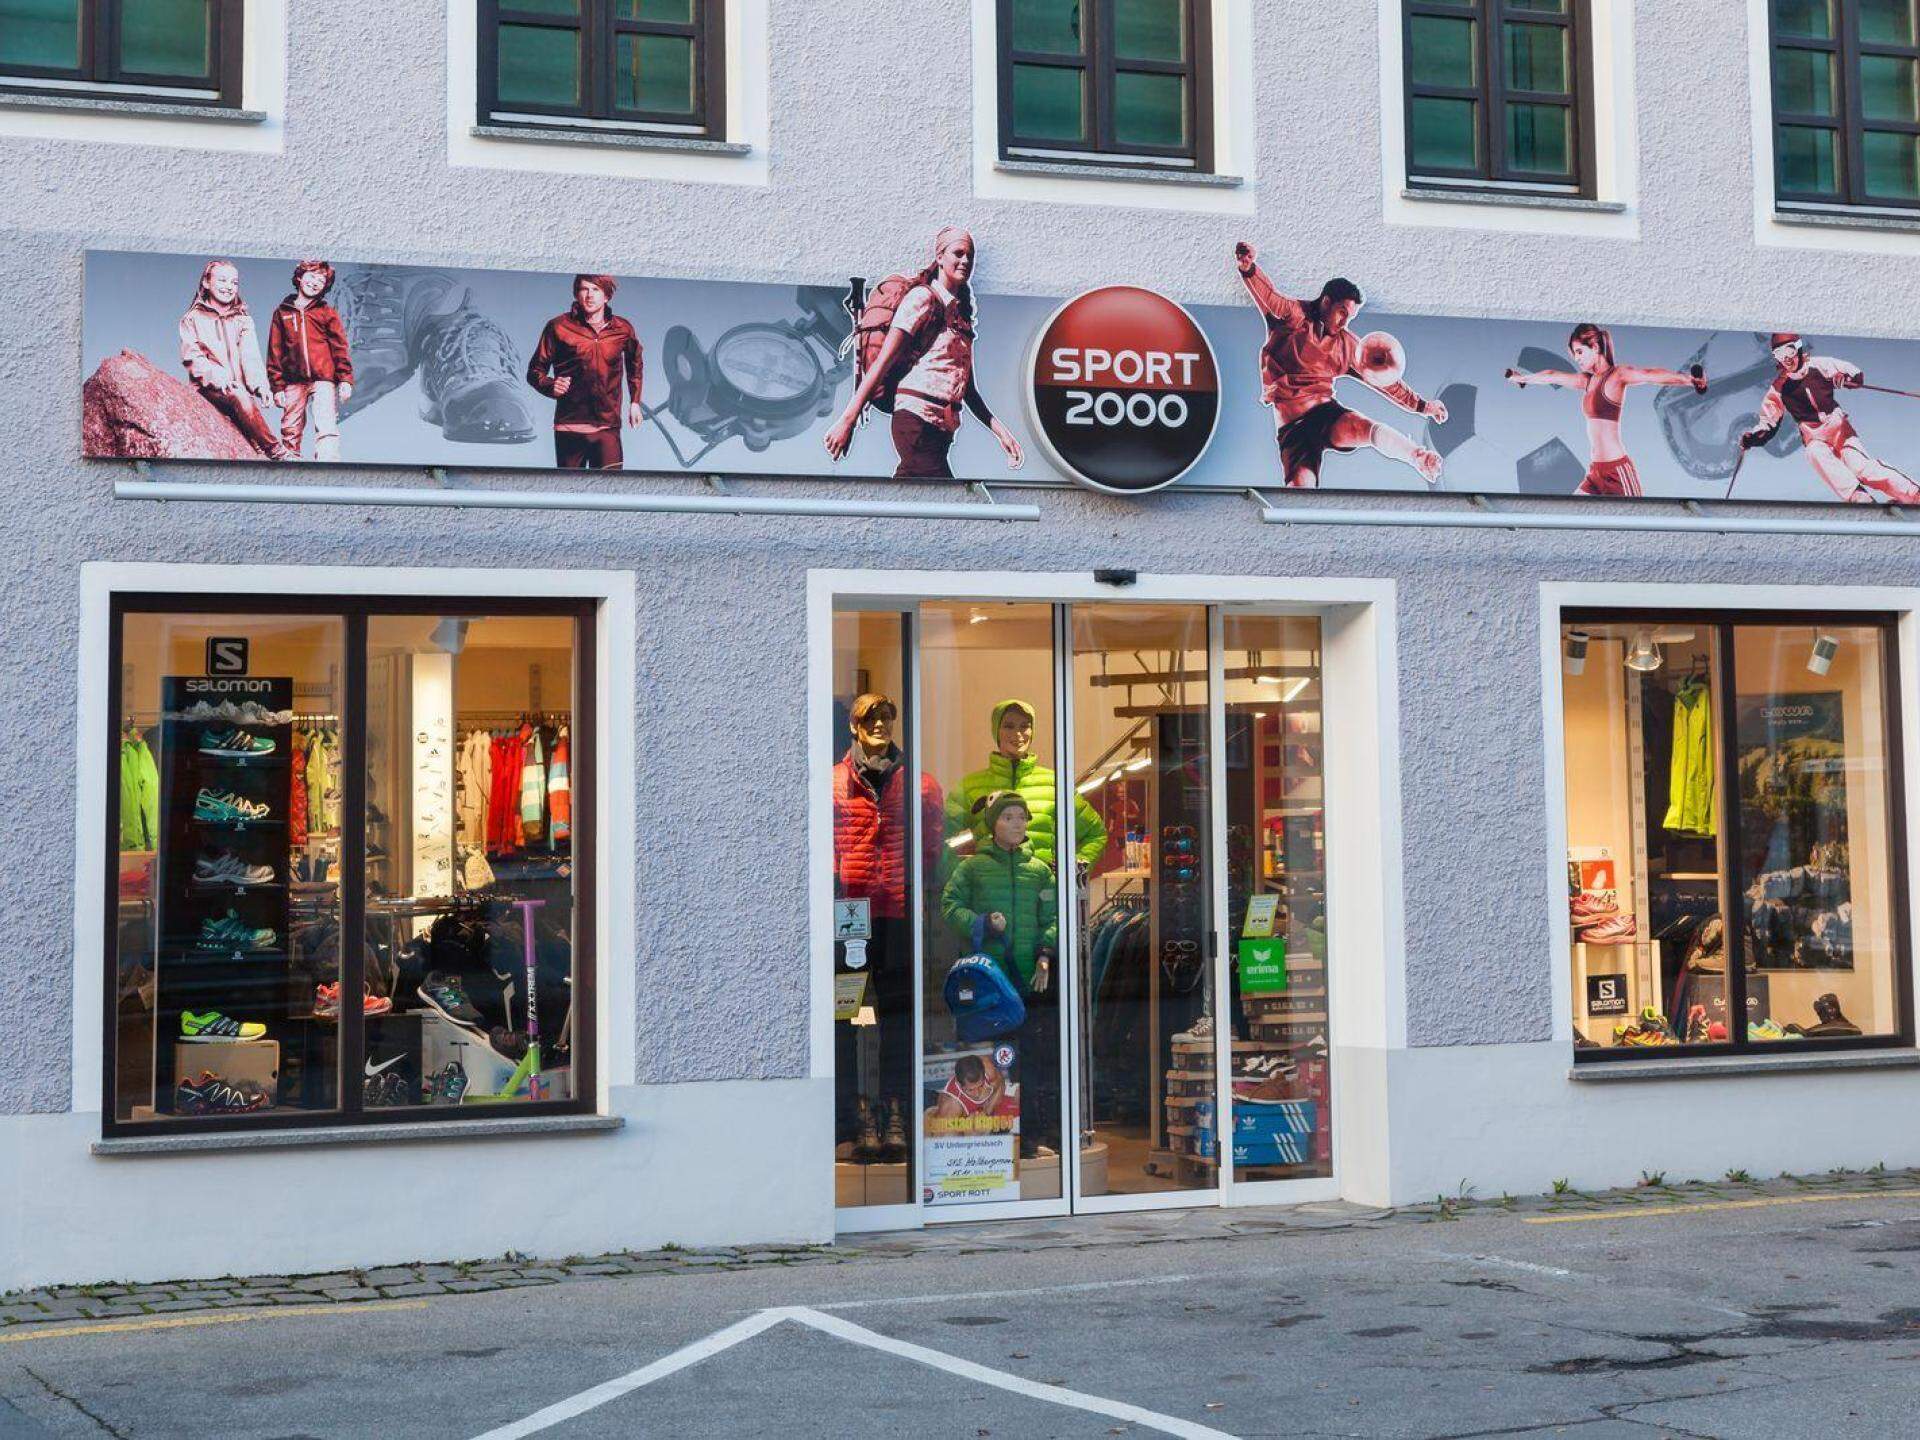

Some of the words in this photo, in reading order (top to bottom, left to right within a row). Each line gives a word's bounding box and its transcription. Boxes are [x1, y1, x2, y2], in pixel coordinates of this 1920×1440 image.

[1052, 347, 1200, 386] SPORT
[1065, 390, 1188, 428] 2000
[215, 642, 243, 670] S
[186, 679, 272, 692] salomon
[1246, 964, 1279, 975] erima
[937, 1190, 967, 1199] SPORT
[969, 1188, 991, 1197] ROTT
